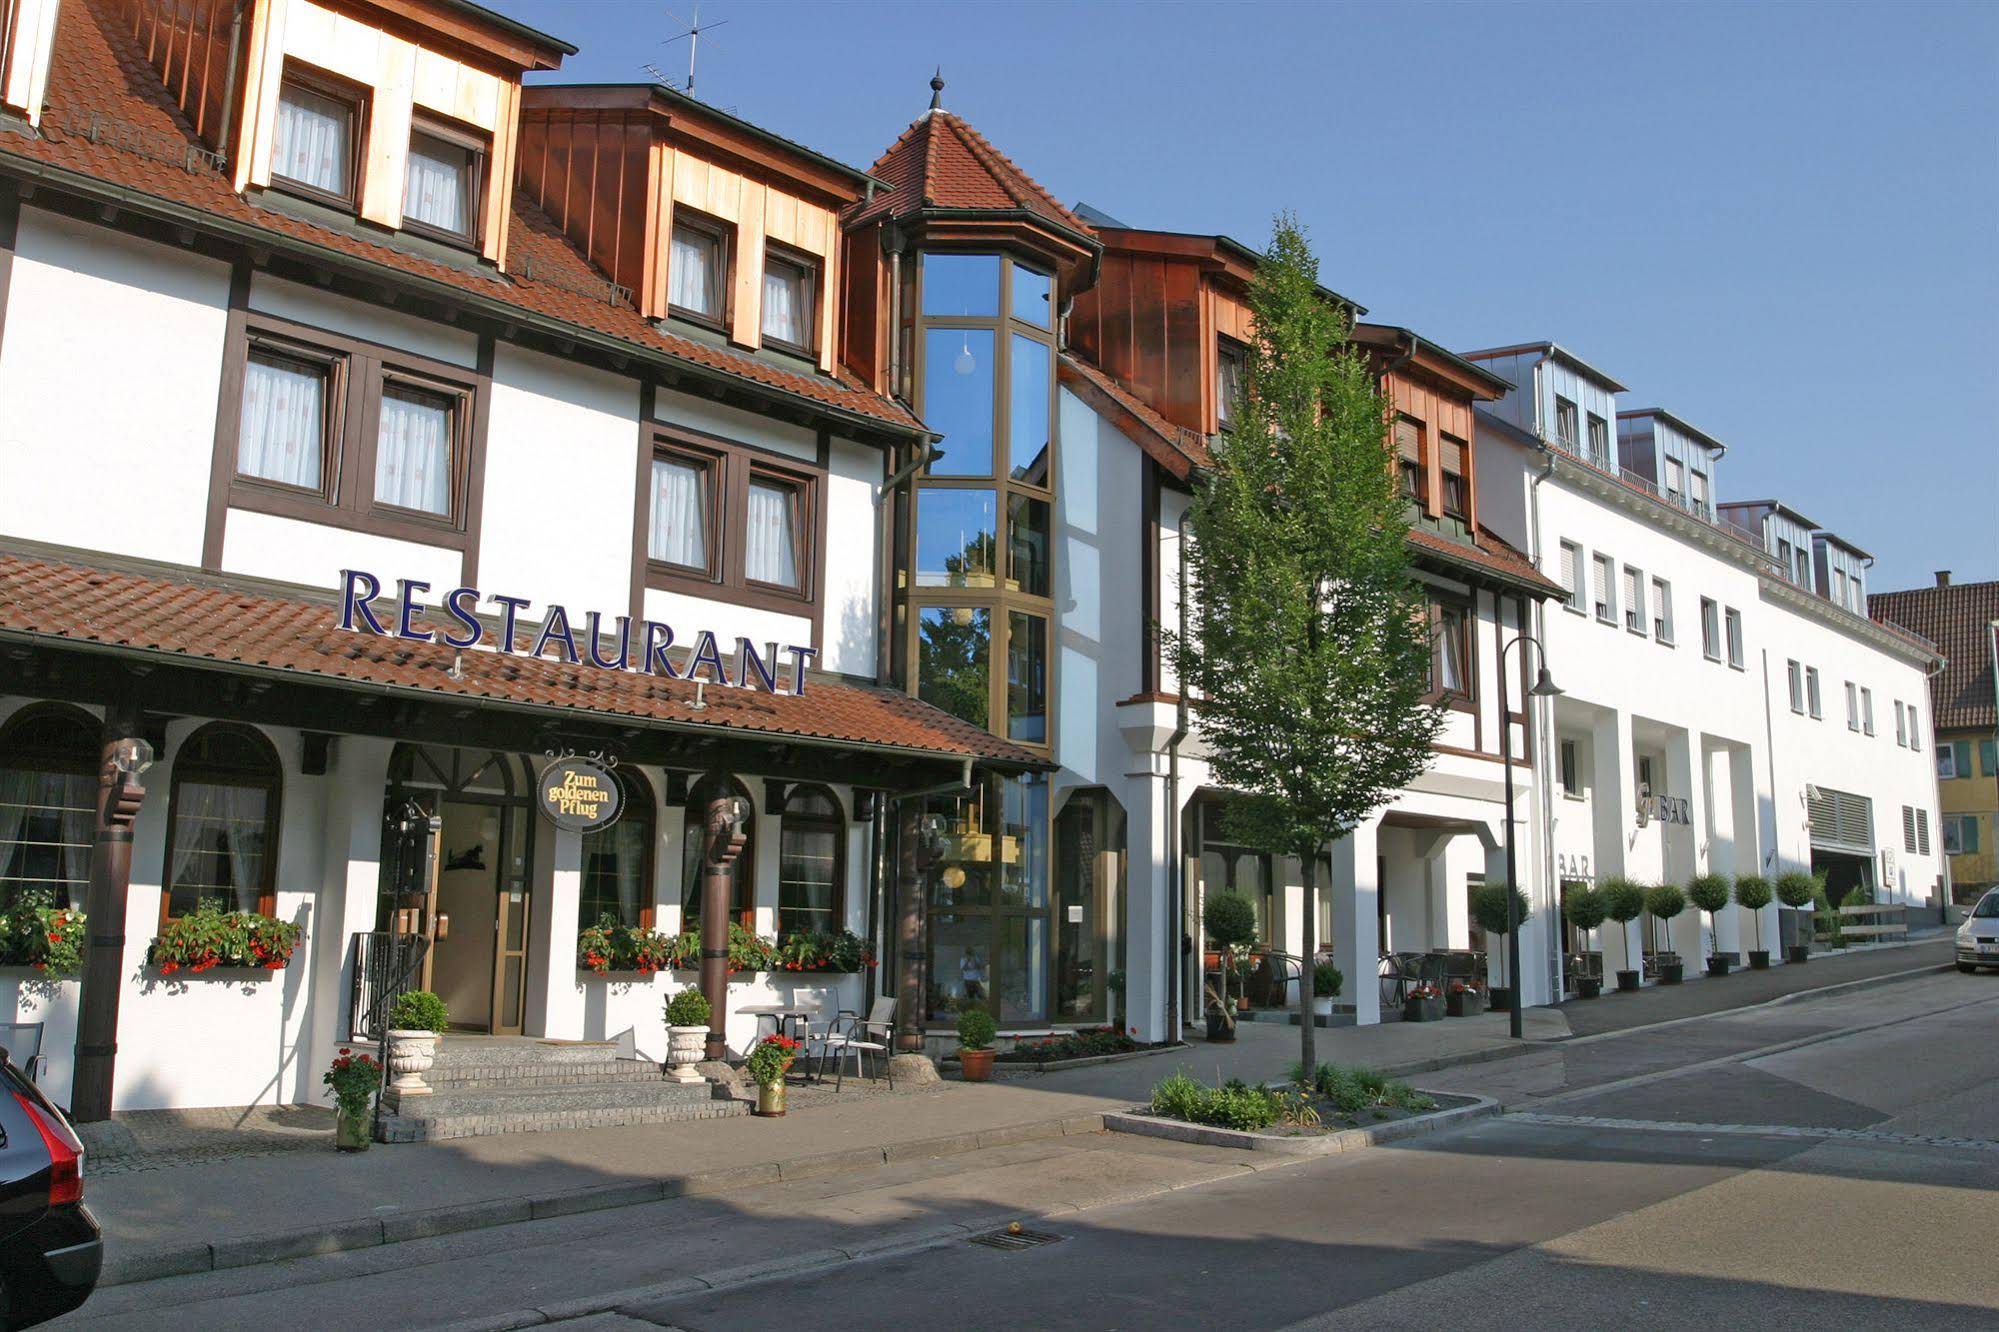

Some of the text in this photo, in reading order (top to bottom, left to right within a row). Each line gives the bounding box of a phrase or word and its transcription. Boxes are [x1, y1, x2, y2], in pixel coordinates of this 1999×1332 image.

[334, 569, 818, 696] RESTAURANT
[564, 770, 597, 787] Zum
[548, 785, 608, 802] goldenen
[560, 799, 597, 818] Pflug
[1658, 794, 1690, 825] BAR
